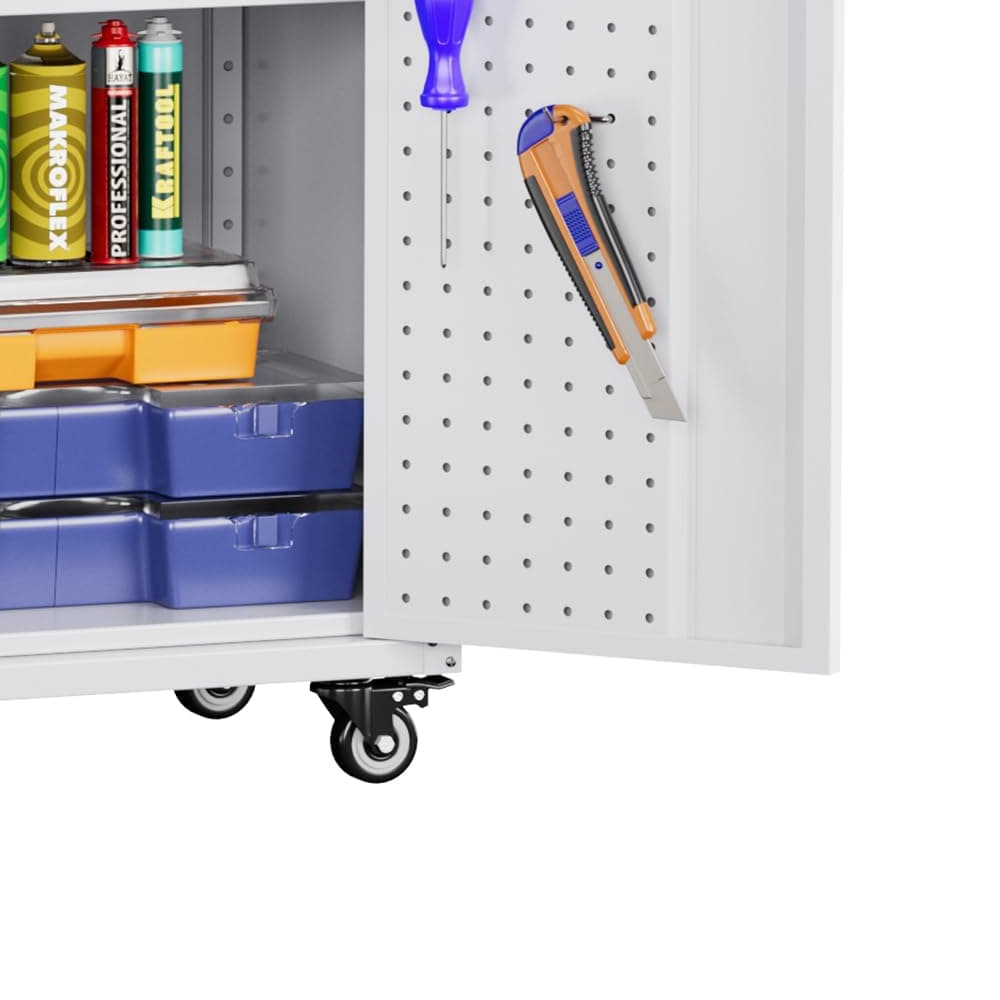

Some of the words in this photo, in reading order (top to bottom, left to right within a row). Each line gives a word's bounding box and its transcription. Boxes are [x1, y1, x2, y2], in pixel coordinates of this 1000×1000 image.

[49, 85, 69, 252] MAKROFLEX
[111, 98, 127, 258] PROFESSIONAL
[151, 84, 176, 219] KRAFTOOL
